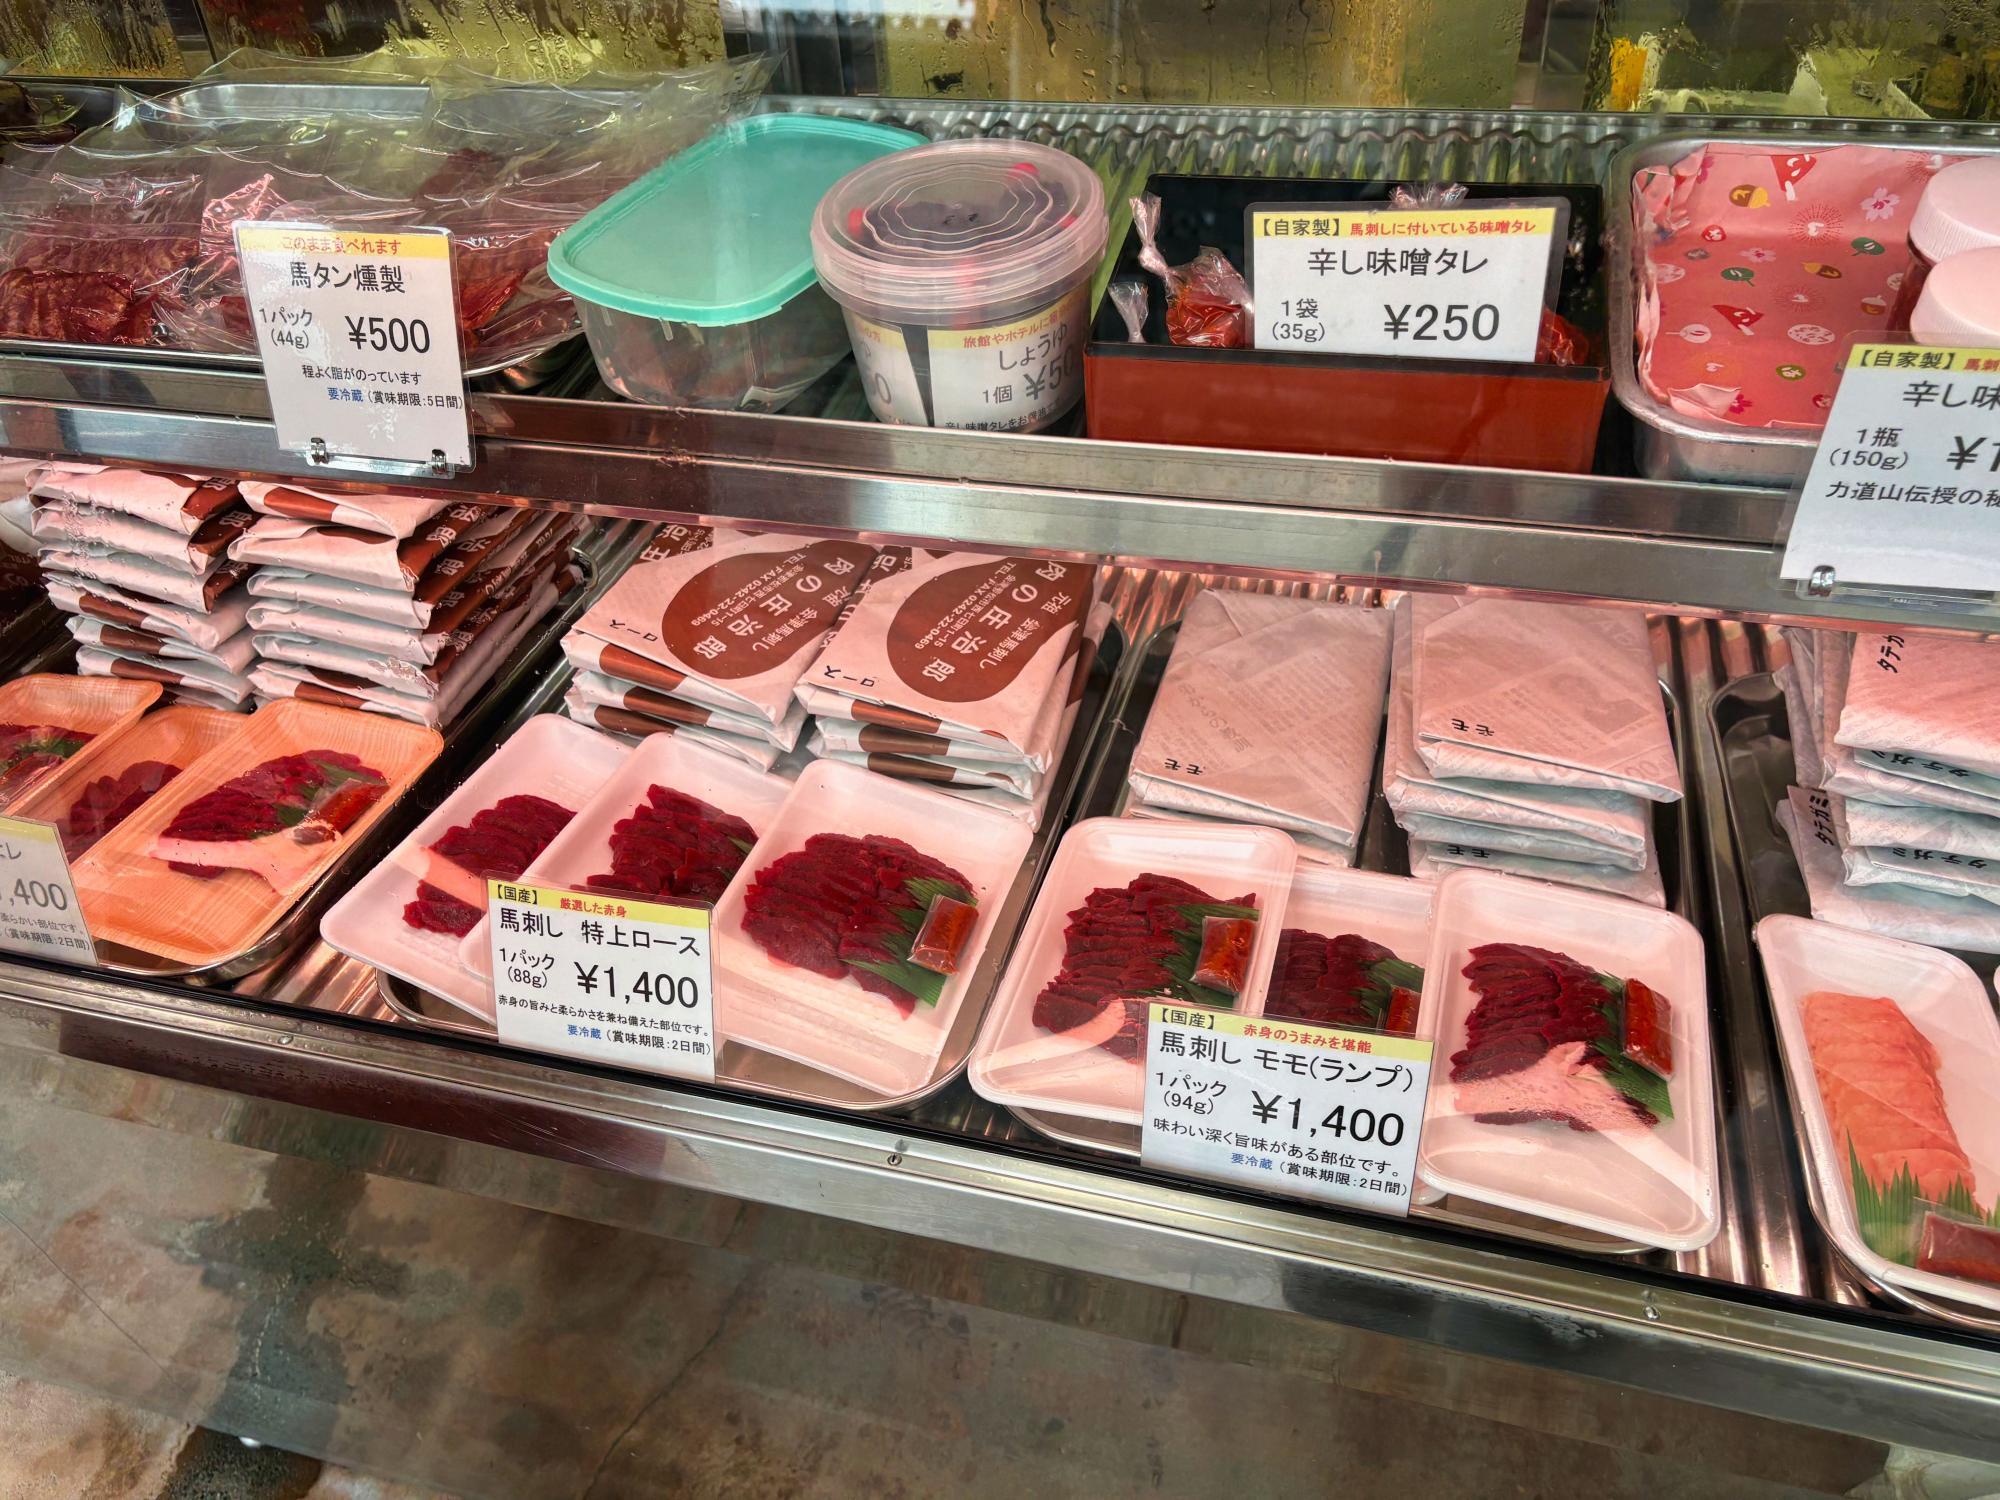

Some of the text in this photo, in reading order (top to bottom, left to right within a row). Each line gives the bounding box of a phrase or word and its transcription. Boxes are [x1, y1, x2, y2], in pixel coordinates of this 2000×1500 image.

[1260, 218, 1536, 237] 【自家製】 馬刺しに付いている味噌タレ
[1307, 248, 1489, 277] 辛し味噌タレ
[290, 261, 406, 294] 馬タン燻製
[259, 308, 313, 326] 1パック
[1281, 298, 1319, 319] 1袋
[1271, 322, 1326, 343] (35g)
[1383, 303, 1501, 342] ¥250
[271, 330, 310, 349] (44g)
[345, 315, 430, 354] ¥500
[1860, 351, 1955, 370] 【自家製】
[302, 364, 421, 385] 程よく脂がのっています
[327, 387, 364, 403] 要冷蔵
[983, 384, 1012, 404] 1個
[1856, 427, 1903, 448] 1瓶
[1829, 448, 1908, 471] (150g)
[915, 593, 978, 650] 0242-22-0469
[824, 665, 875, 688] ロース
[1164, 758, 1203, 776] モモ
[0, 878, 67, 911] ,400
[496, 884, 628, 918] 【国産】 厳選した赤身
[500, 907, 701, 957] 馬刺し 特上ロース
[499, 948, 555, 970] 1パック
[507, 966, 548, 989] (88g)
[573, 961, 698, 1009] ¥1,400
[567, 1024, 602, 1041] 要冷蔵
[1159, 1008, 1372, 1054] 【国産】 赤身のうまみを堪能
[1159, 1031, 1413, 1093] 馬刺し モモ(ランプ)
[1155, 1072, 1227, 1097] 1パック
[1163, 1090, 1215, 1116] (94g)
[1251, 1090, 1405, 1147] ¥1,400
[1153, 1118, 1400, 1177] 味わい深く旨味がある部位です。
[1230, 1153, 1273, 1171] 要冷蔵
